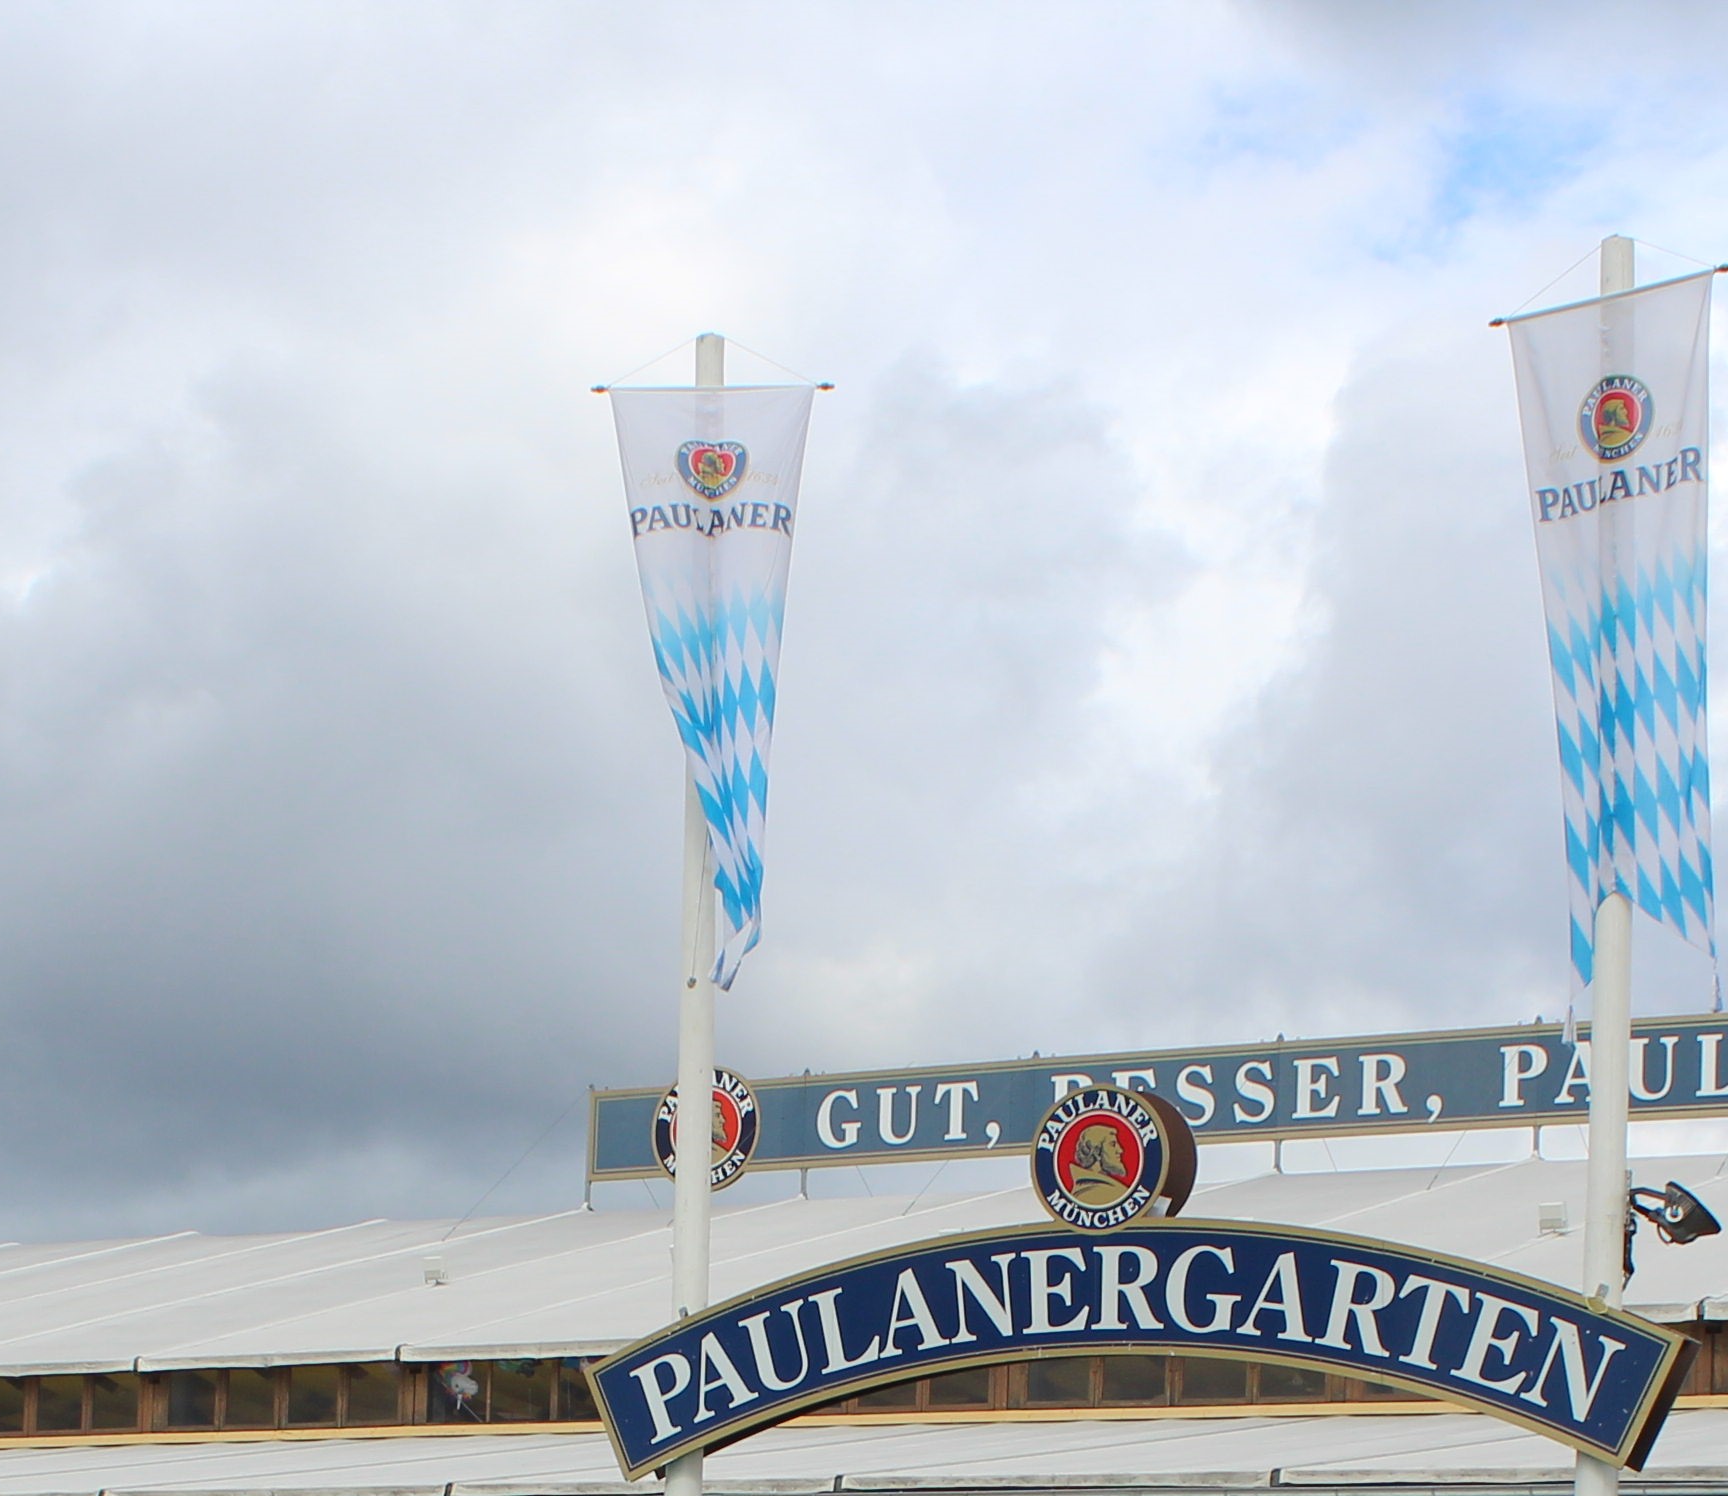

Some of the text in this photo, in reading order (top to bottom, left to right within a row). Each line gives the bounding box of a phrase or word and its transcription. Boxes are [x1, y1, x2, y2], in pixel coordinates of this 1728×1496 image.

[1535, 446, 1703, 522] PAULANER
[630, 501, 792, 540] PAULANER
[815, 1080, 1003, 1150] GUT,
[1038, 1090, 1158, 1152] PAULANER
[1046, 1185, 1151, 1228] MÜNCHEN
[629, 1244, 1626, 1447] PAULANERGARTEN
